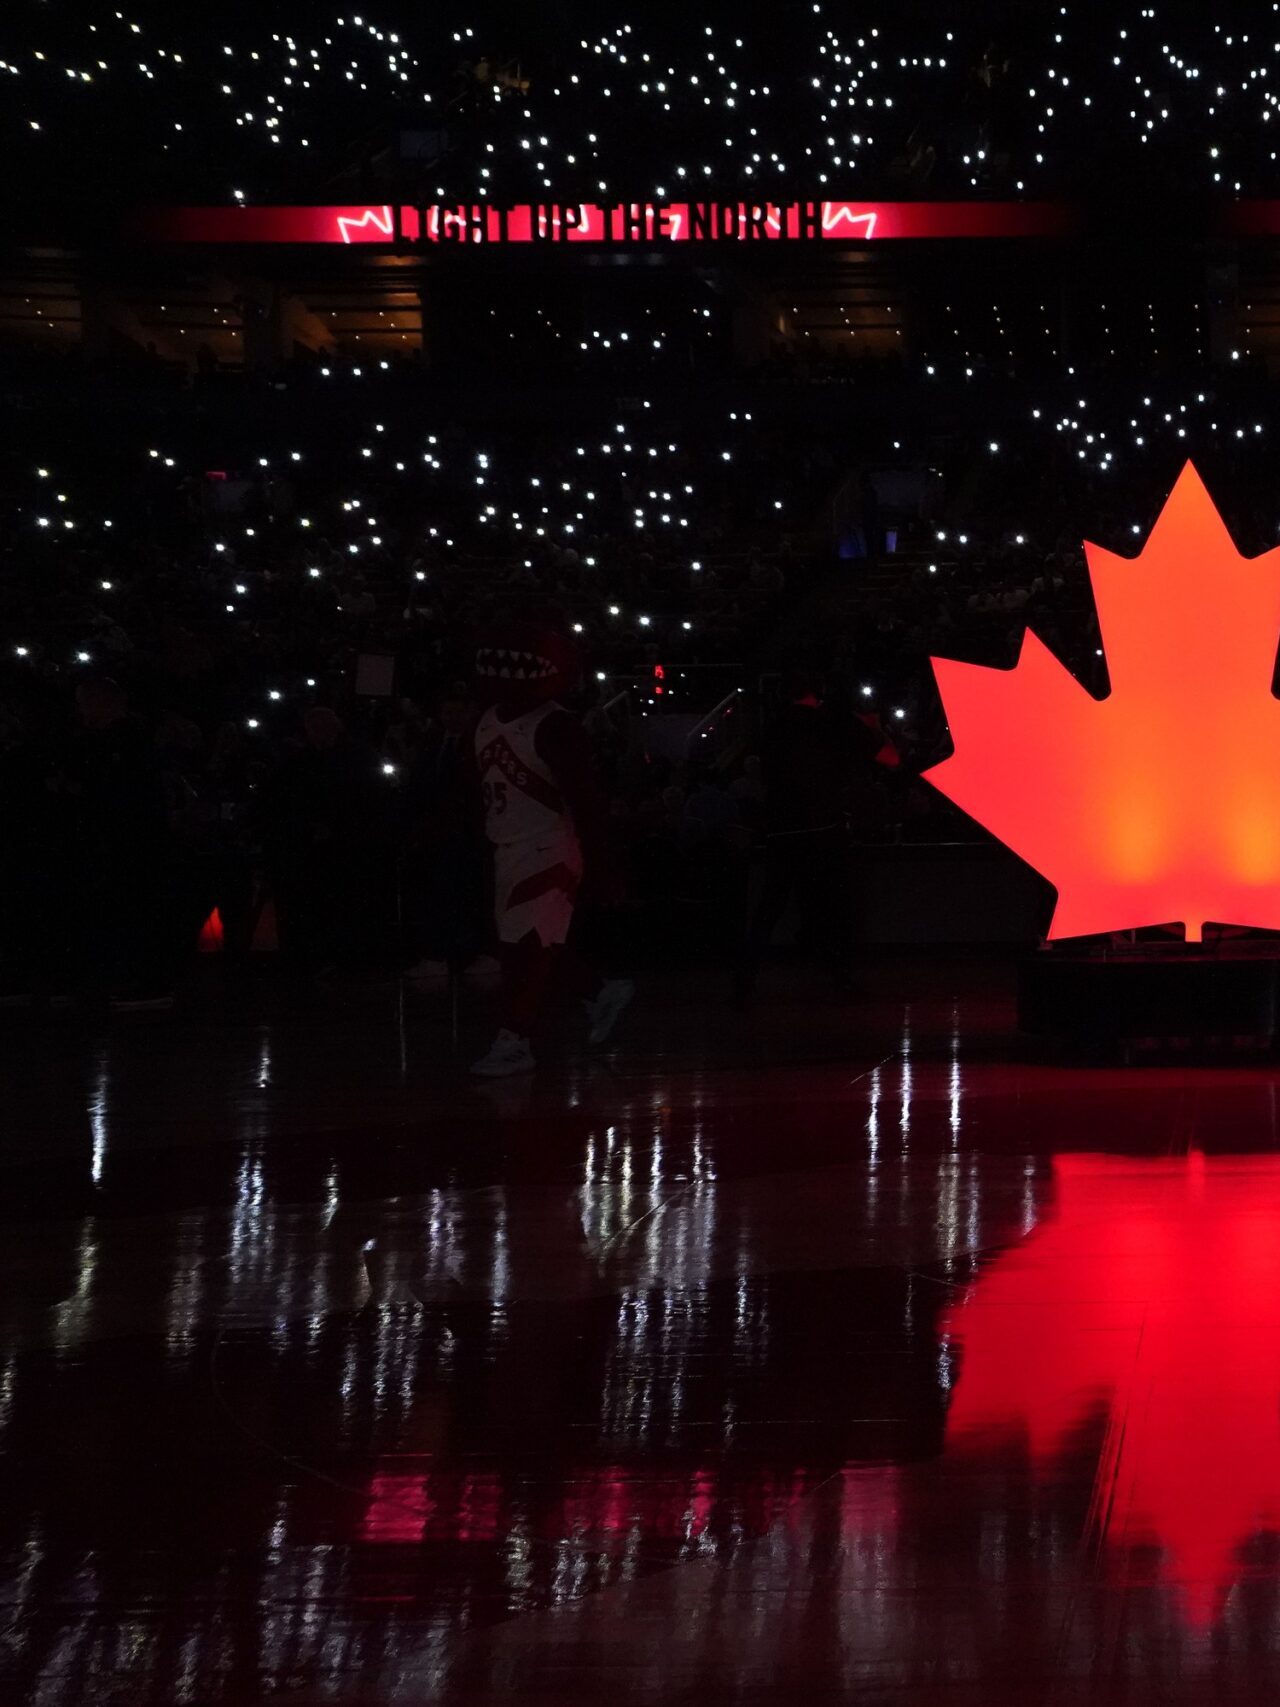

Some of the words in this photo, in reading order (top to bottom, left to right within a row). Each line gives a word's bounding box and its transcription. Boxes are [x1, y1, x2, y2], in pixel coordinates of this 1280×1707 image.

[393, 202, 515, 244] LIGHT
[531, 202, 579, 243] UP
[596, 202, 671, 243] THE
[687, 201, 822, 242] NORTH
